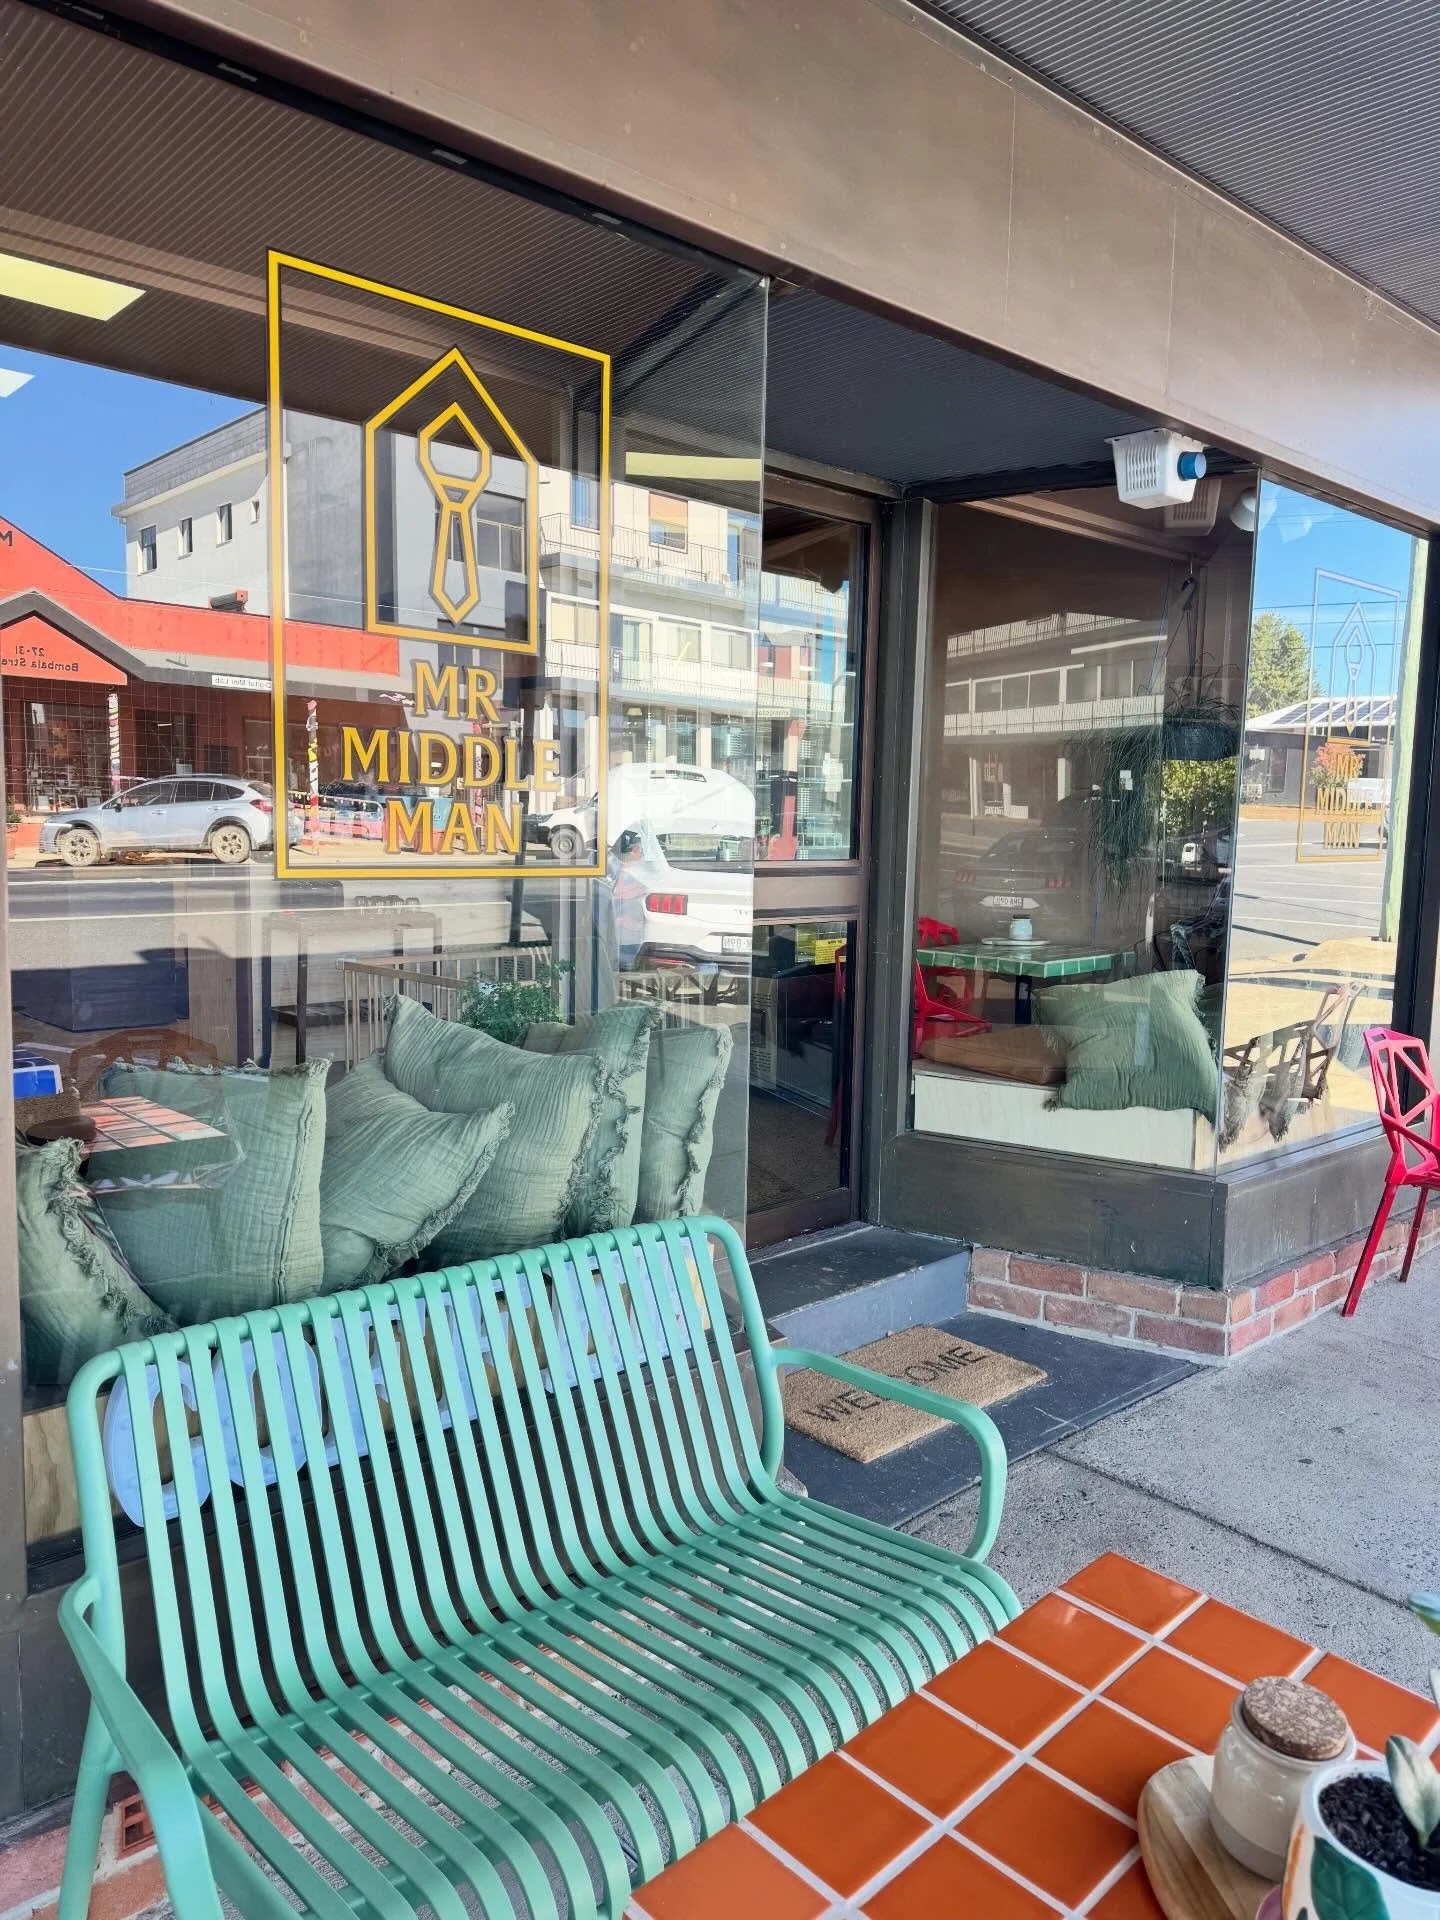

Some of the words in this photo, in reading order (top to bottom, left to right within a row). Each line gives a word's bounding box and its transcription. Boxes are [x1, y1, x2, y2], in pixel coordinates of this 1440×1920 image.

[414, 660, 500, 722] MR
[340, 726, 562, 792] MIDDLE
[385, 798, 525, 856] MAN
[1323, 820, 1361, 850] MAN
